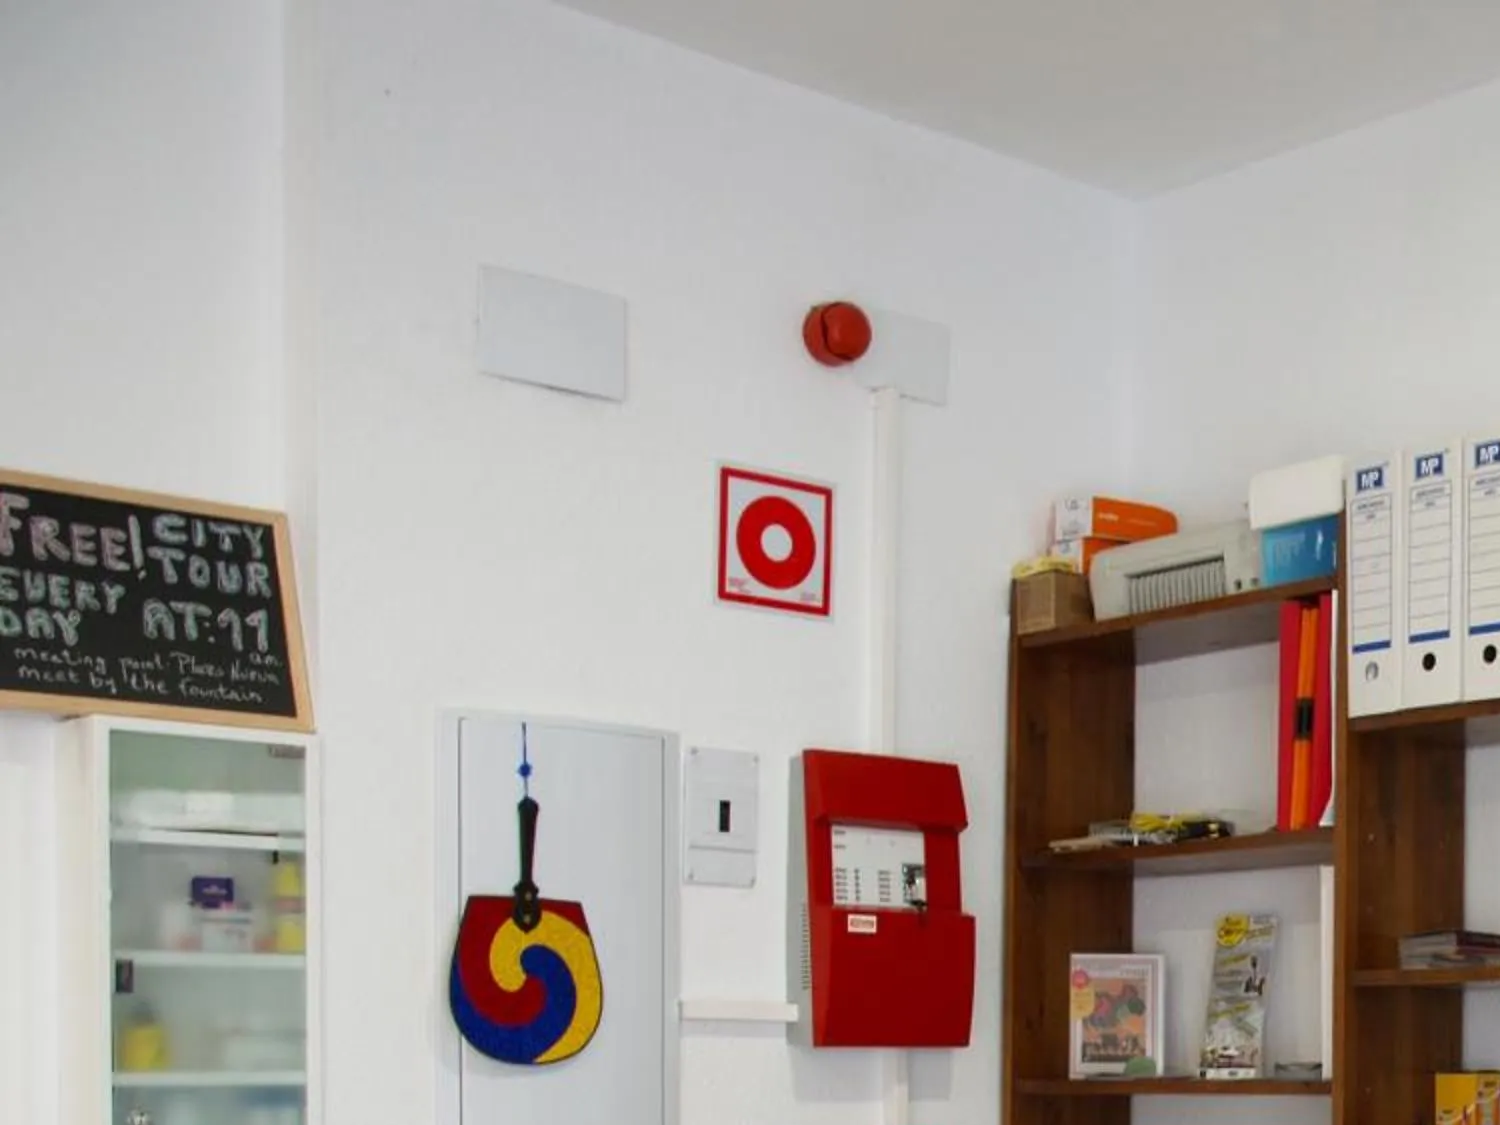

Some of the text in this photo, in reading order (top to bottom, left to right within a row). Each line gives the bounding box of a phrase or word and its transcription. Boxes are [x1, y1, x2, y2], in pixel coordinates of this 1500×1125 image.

[152, 513, 266, 559] CITY
[147, 546, 272, 599] TOUR
[0, 606, 82, 647] DAY
[18, 664, 263, 703] meet by the fountain
